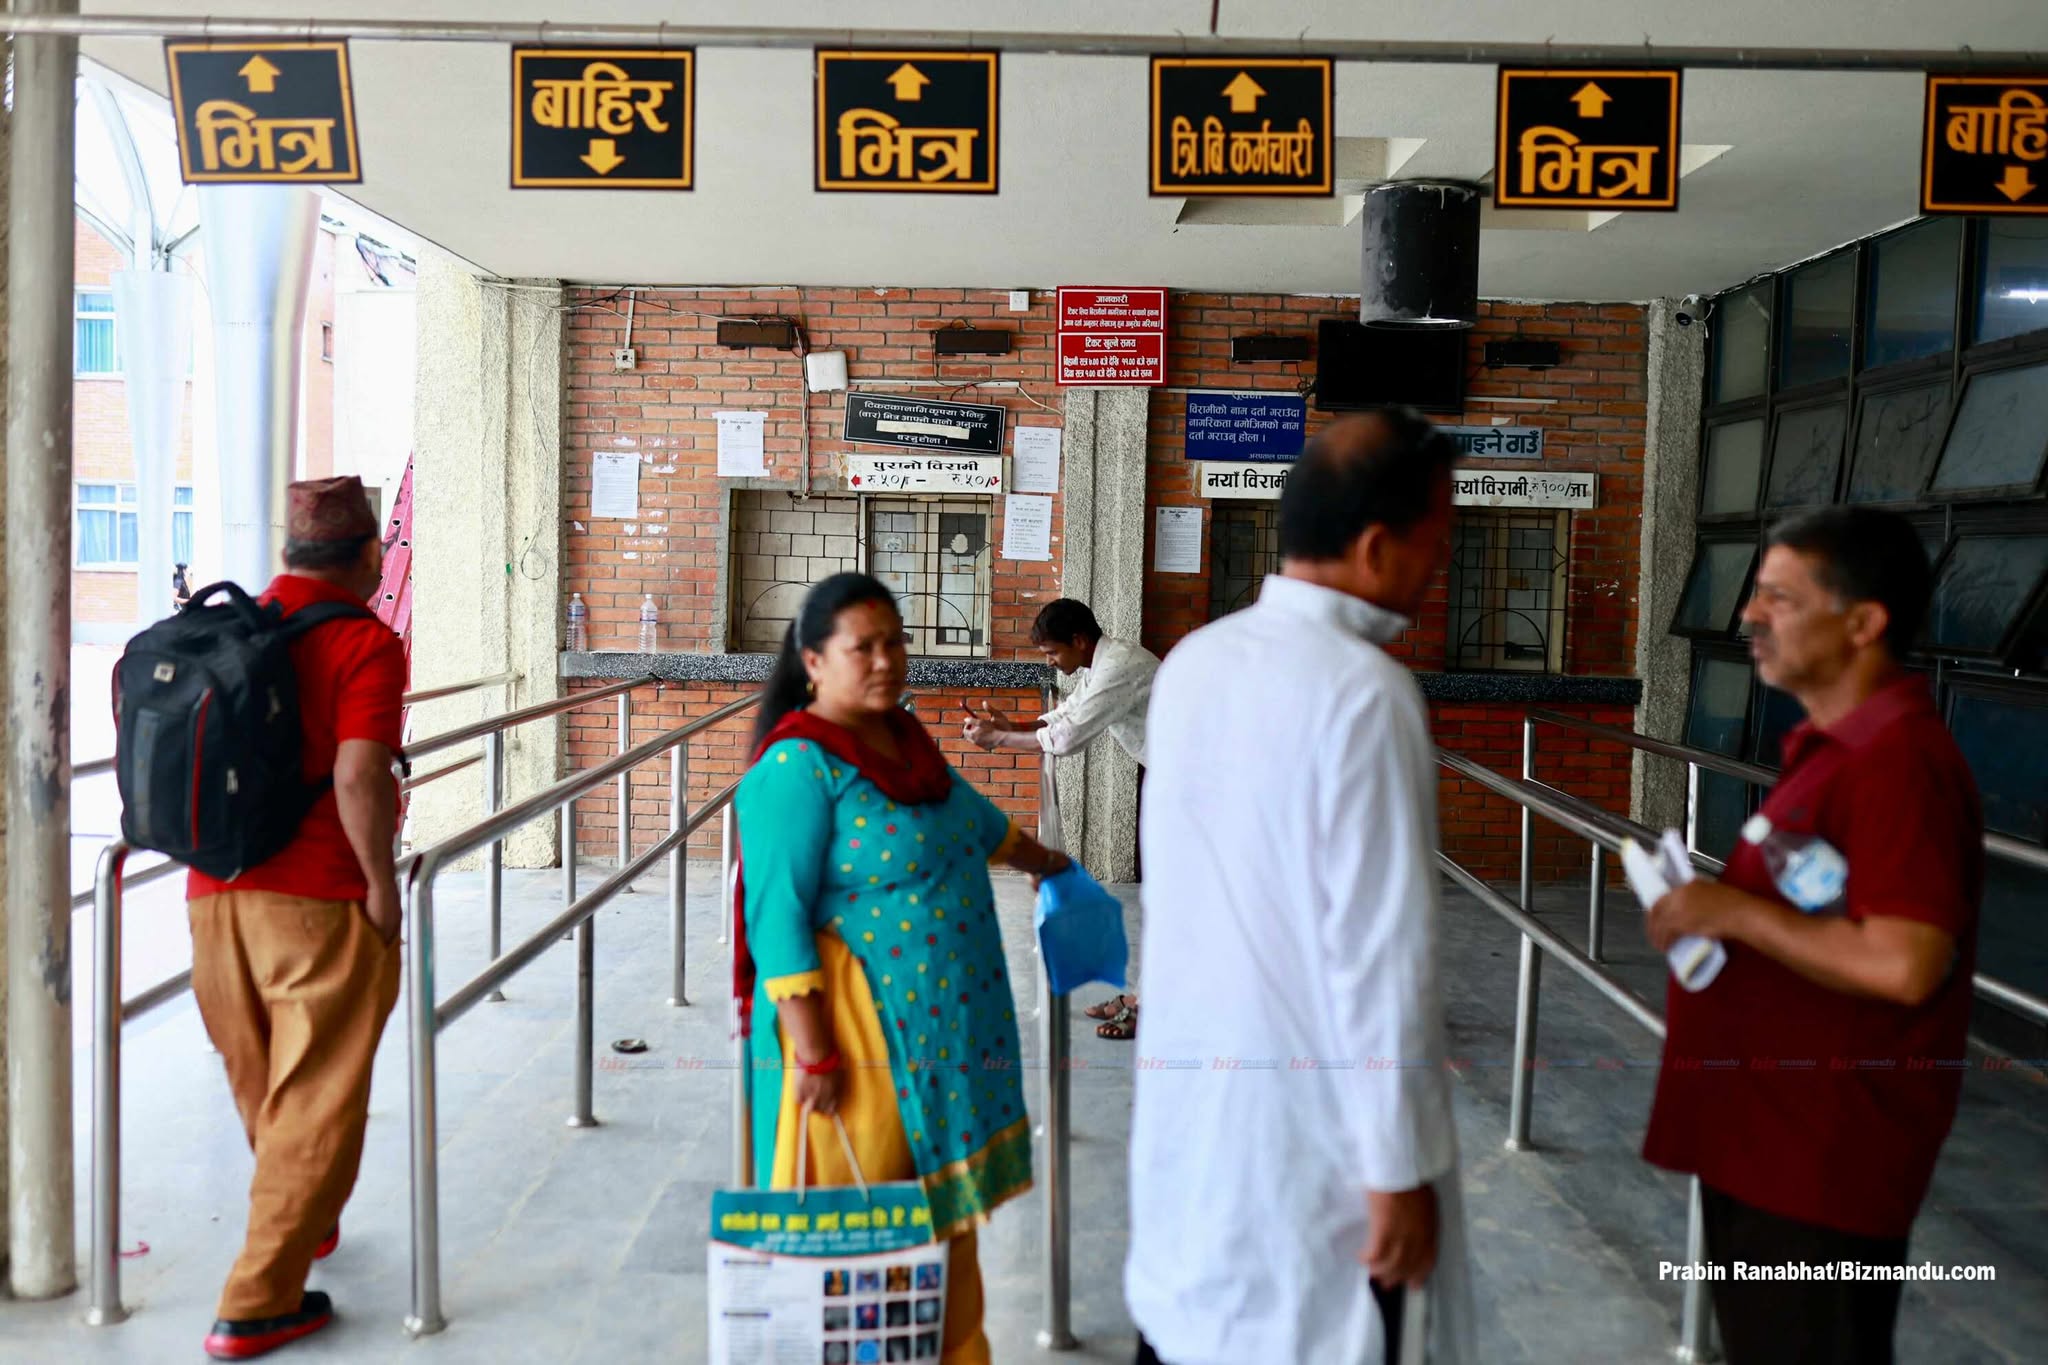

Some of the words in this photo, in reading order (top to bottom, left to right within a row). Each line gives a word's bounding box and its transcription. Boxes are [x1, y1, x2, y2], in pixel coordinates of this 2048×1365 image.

[531, 61, 675, 135] बाहिर
[196, 100, 336, 174] भित्र
[1946, 89, 2048, 161] बाहि
[837, 108, 979, 182] भित्र
[1229, 117, 1314, 178] कर्मचारी
[1518, 125, 1659, 198] भित्र
[1085, 336, 1101, 347] टिकट
[1120, 339, 1136, 347] समय
[1230, 407, 1247, 415] नाम
[1189, 416, 1231, 428] नागरिकता
[1234, 418, 1279, 430] बमोजिमको
[1282, 422, 1300, 431] नाम
[1239, 431, 1259, 443] होला
[1506, 430, 1540, 454] ठाउँ
[873, 460, 922, 472] पुरानो
[1208, 471, 1240, 488] नयाँ
